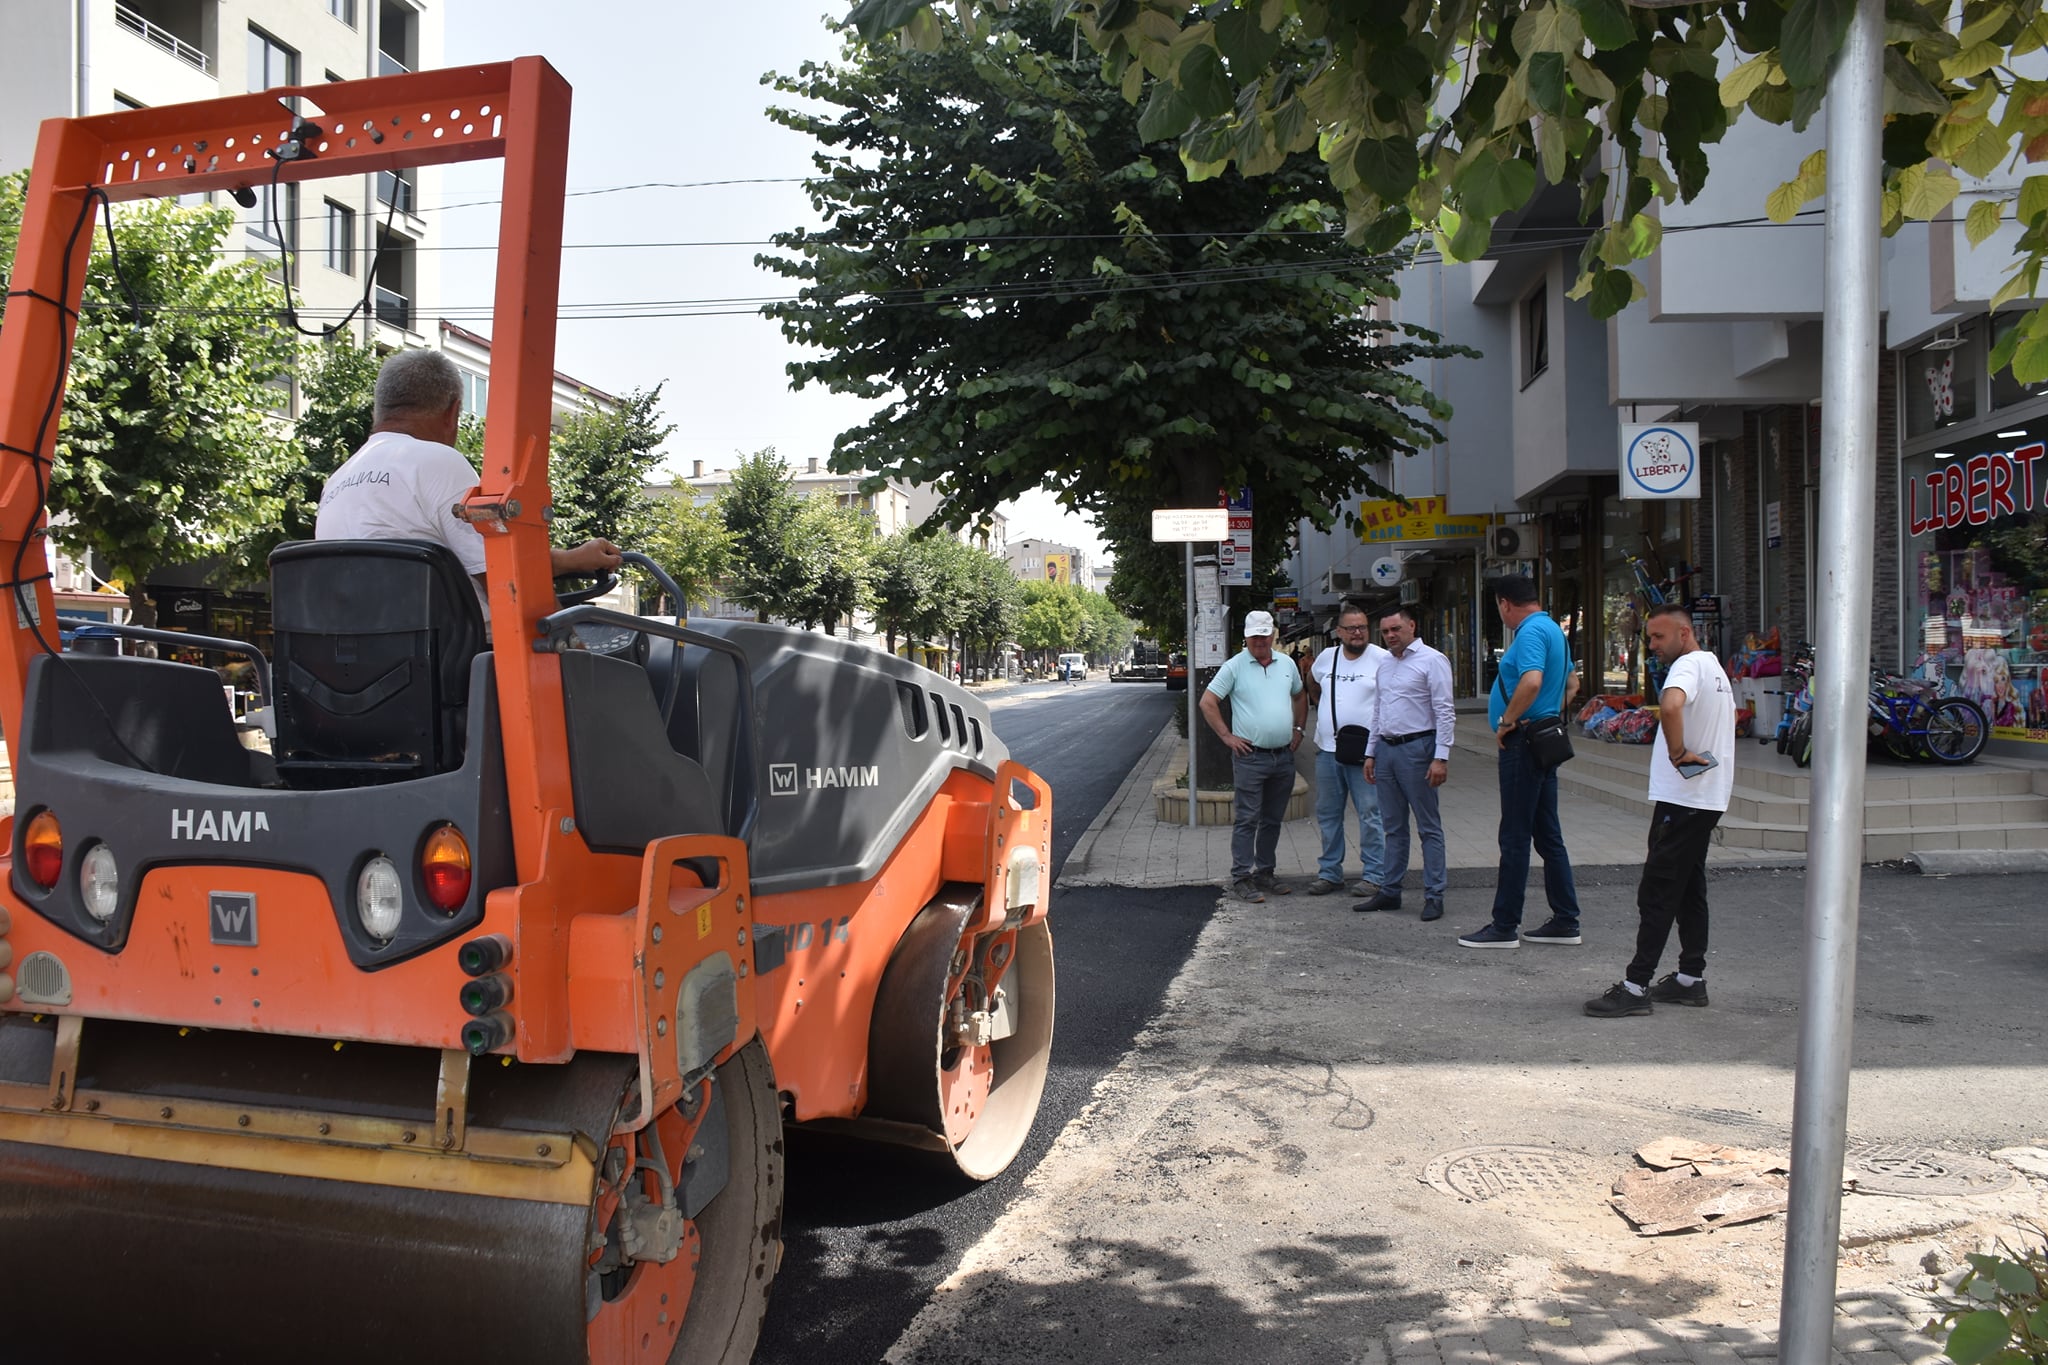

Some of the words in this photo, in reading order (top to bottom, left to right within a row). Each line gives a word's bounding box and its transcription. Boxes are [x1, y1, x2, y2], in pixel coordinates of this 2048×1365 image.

[1636, 463, 1687, 478] LIBERTA
[1909, 443, 2048, 537] LIBERT
[1236, 520, 1250, 529] 300
[2025, 729, 2048, 740] LIBER
[806, 765, 880, 789] HAMM
[820, 915, 850, 947] 14
